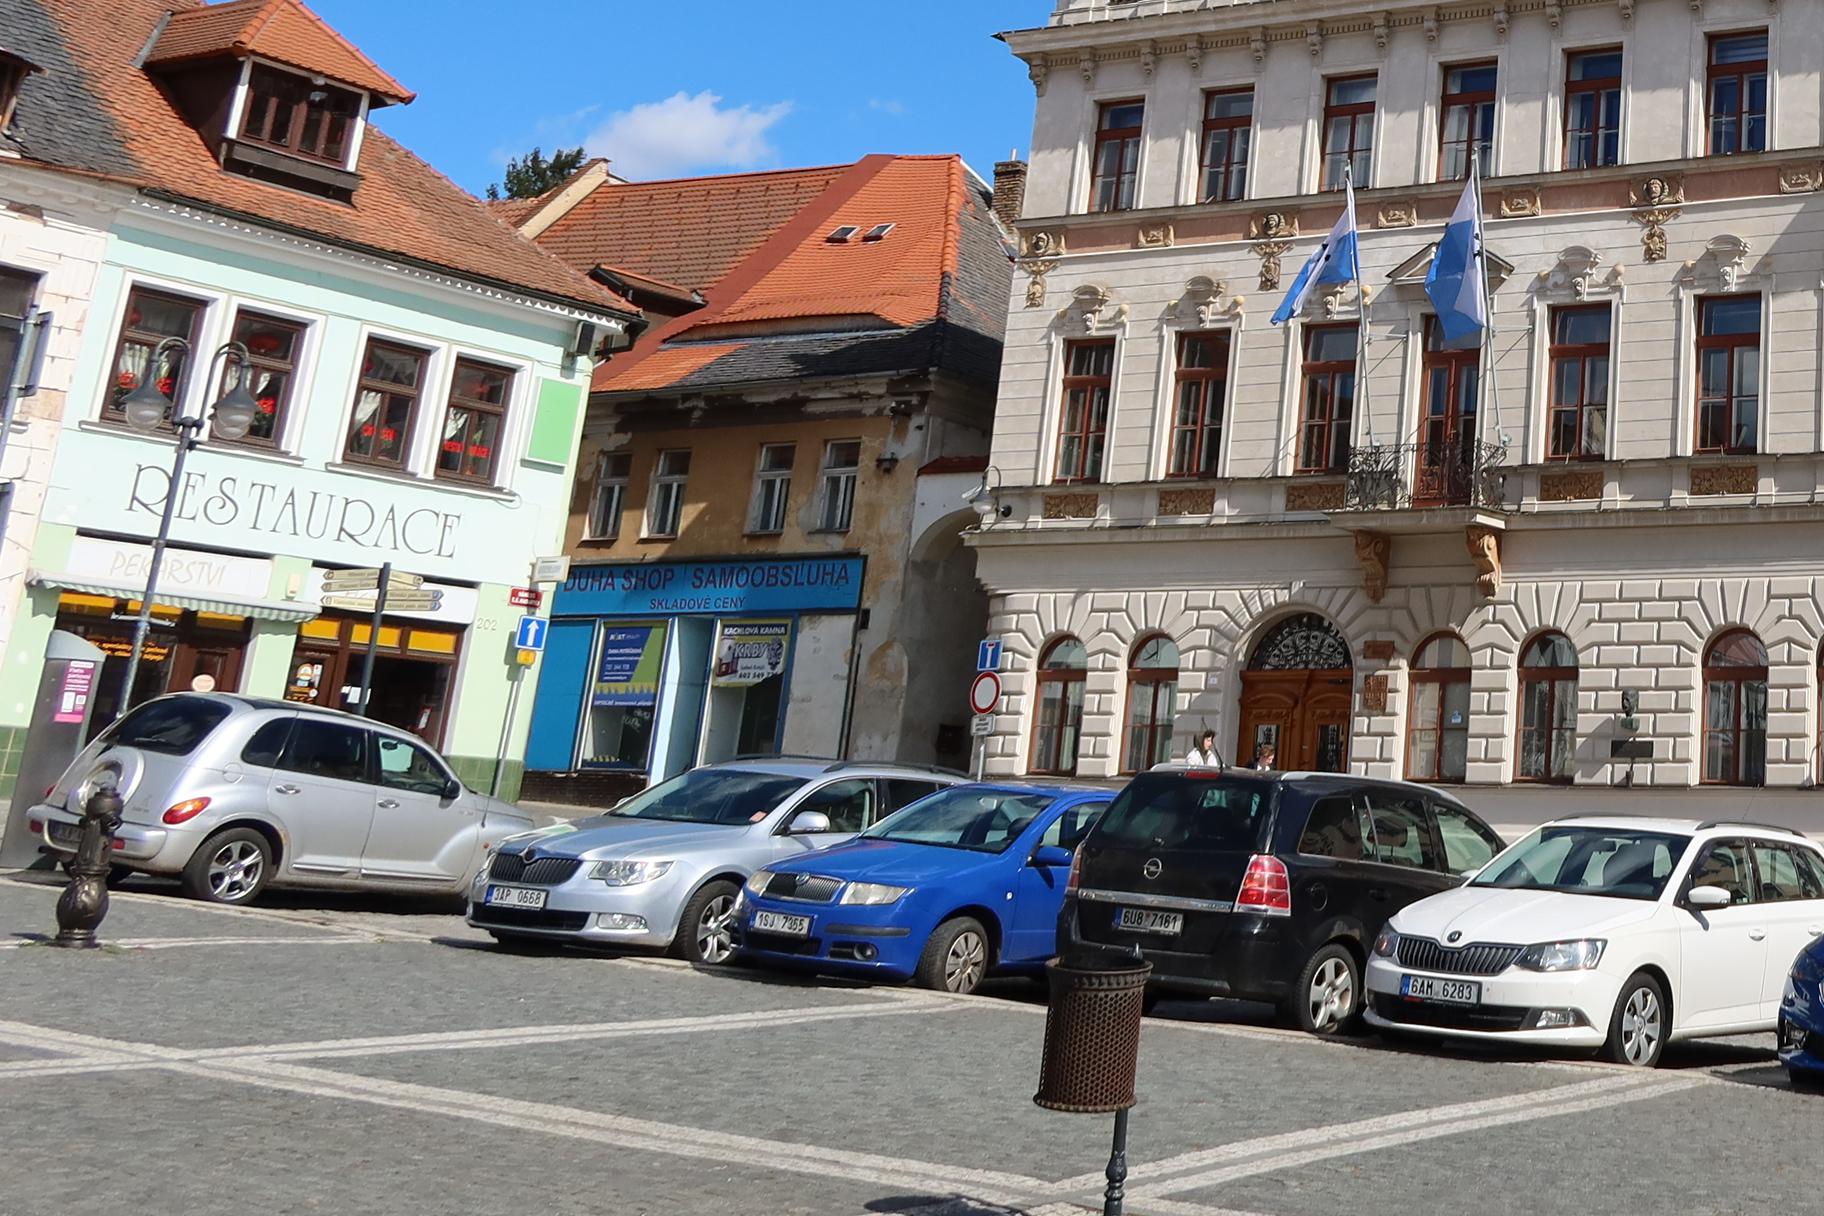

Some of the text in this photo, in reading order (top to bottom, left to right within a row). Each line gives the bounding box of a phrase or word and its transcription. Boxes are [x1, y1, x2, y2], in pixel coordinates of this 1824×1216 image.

[125, 463, 462, 559] RESTAURACE
[563, 570, 616, 592] DUHA
[621, 568, 675, 590] SHOP
[691, 563, 849, 590] SAMOOBSLUHA
[650, 595, 746, 610] SKLADOVÉ CENY
[476, 617, 497, 631] 202
[734, 642, 768, 658] KRBY
[494, 887, 541, 905] 3AP 0668
[758, 913, 805, 932] 1SJ 7355
[1123, 910, 1178, 930] 6U8 7161
[1442, 982, 1473, 1000] 6283
